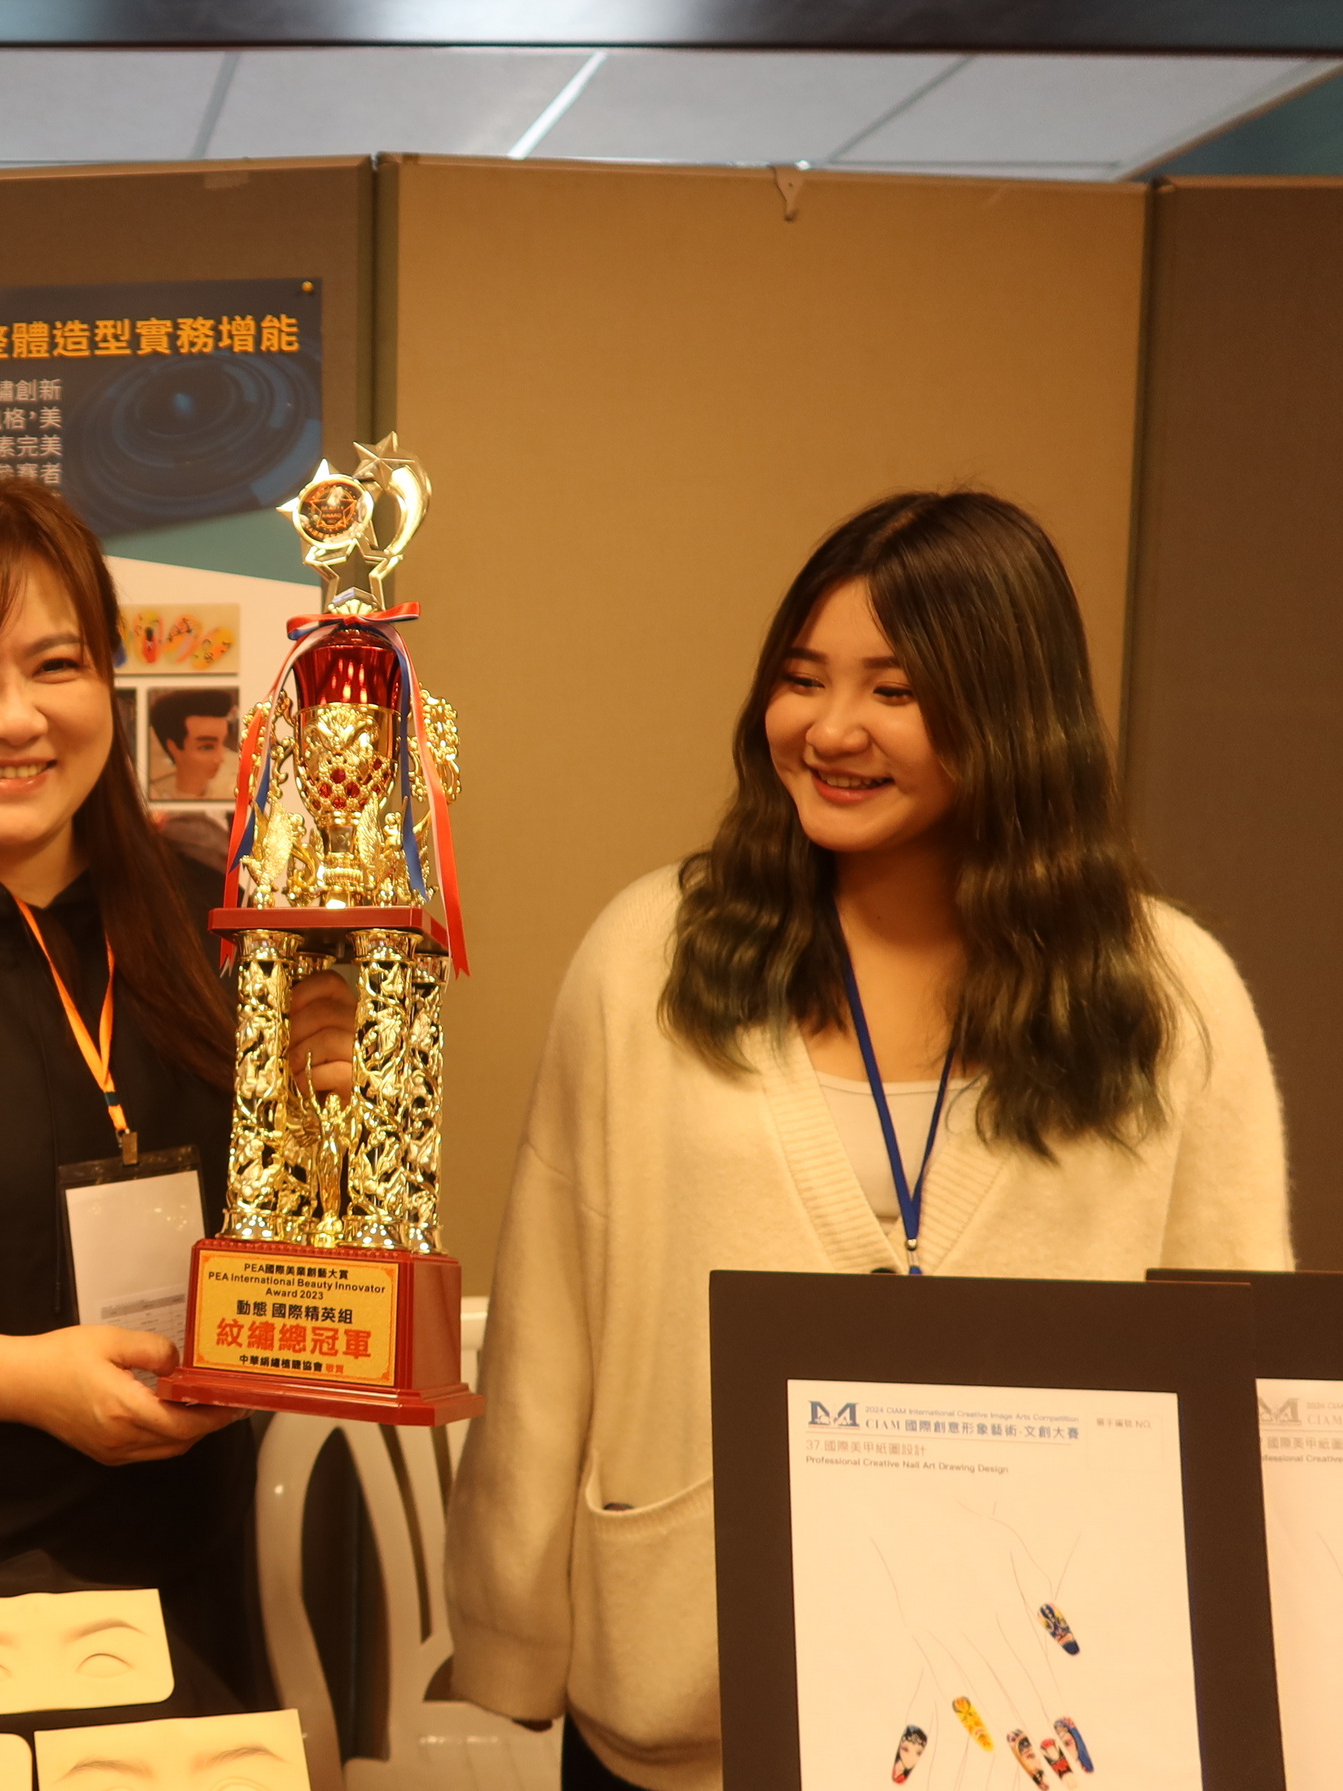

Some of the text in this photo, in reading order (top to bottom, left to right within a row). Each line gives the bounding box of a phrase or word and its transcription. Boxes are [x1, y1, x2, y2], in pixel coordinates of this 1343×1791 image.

[208, 1271, 386, 1294] PEA International Beauty Innovator
[265, 1287, 324, 1300] Award 2023
[236, 1300, 354, 1324] 動態 國際精英組
[216, 1317, 372, 1360] 紋繡總冠軍
[865, 1406, 884, 1414] 2024
[908, 1408, 955, 1417] International
[865, 1418, 900, 1430] CIAM
[806, 1455, 1009, 1475] Professional Creative Nail Art Drawing Design
